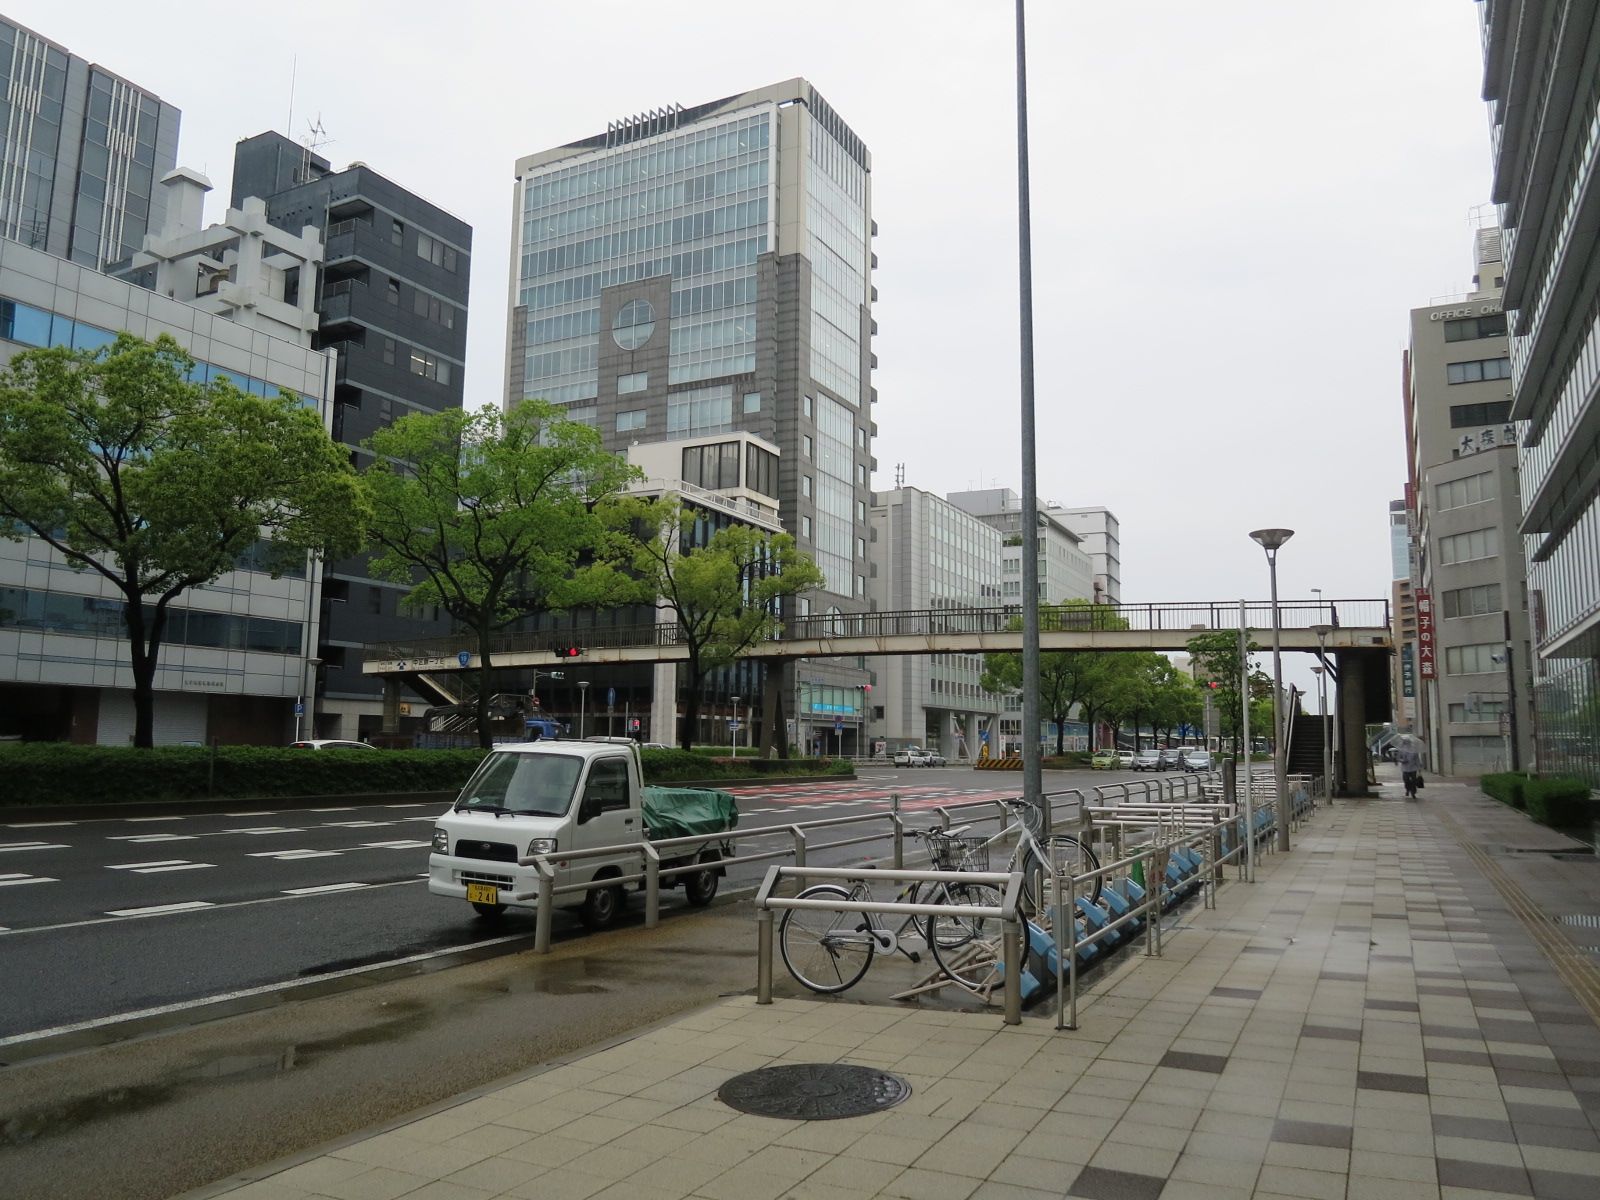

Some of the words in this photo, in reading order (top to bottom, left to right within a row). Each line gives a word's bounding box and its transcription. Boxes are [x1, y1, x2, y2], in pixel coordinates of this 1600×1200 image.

[1430, 307, 1472, 321] OFFICE
[1418, 599, 1433, 674] 帽子の大森
[297, 704, 303, 712] P
